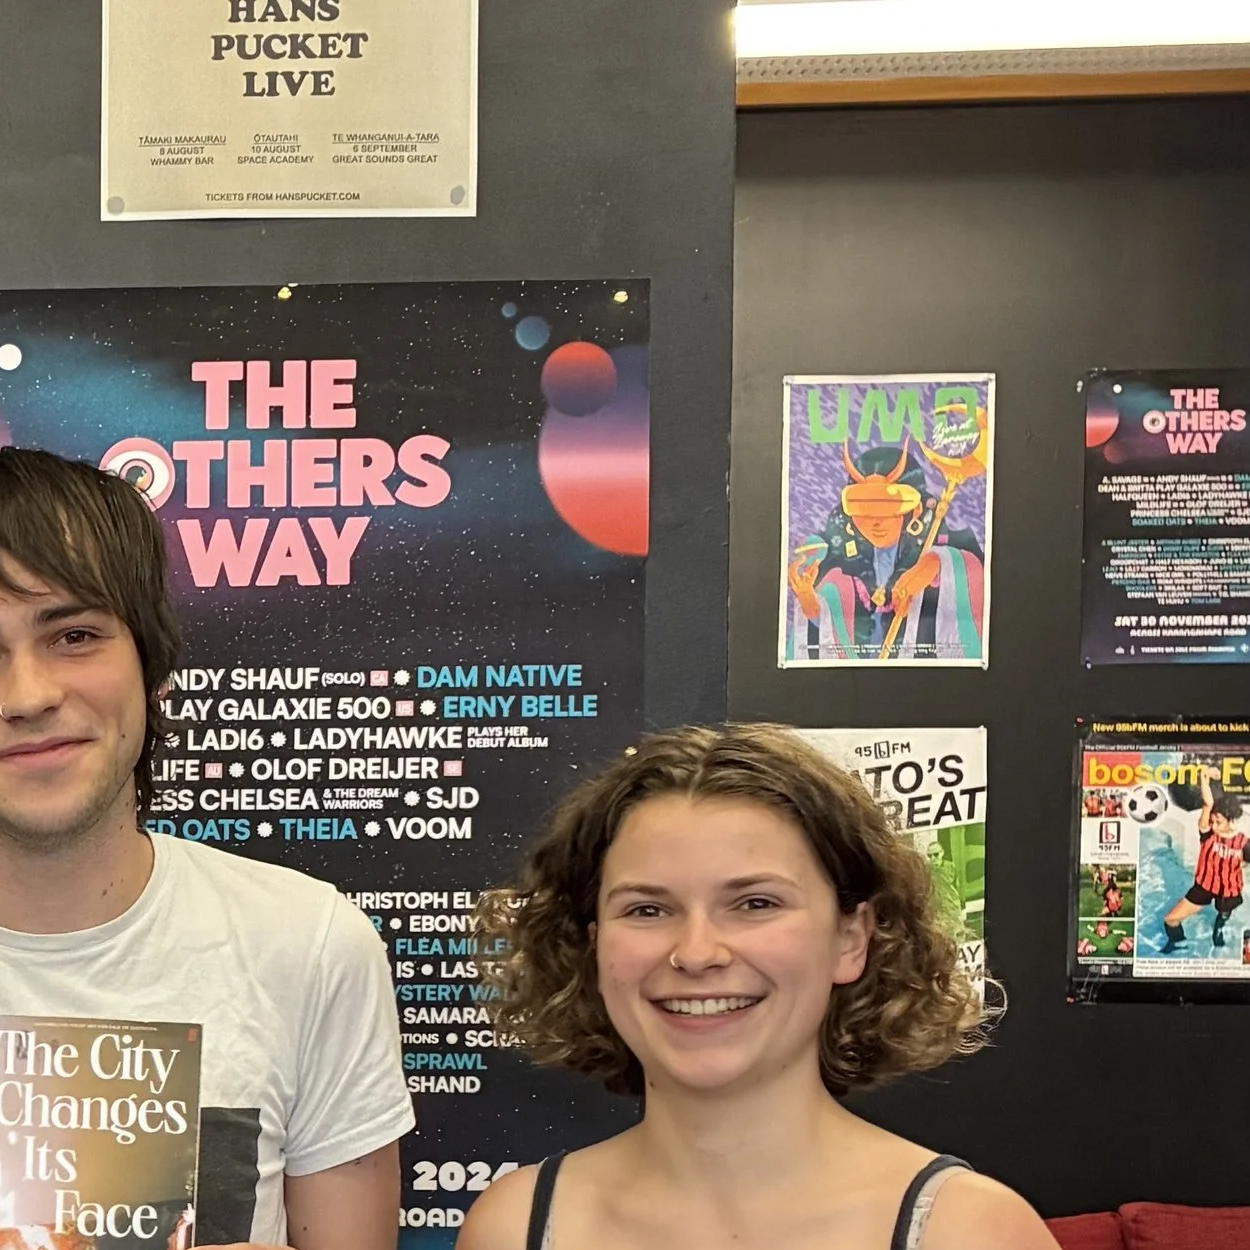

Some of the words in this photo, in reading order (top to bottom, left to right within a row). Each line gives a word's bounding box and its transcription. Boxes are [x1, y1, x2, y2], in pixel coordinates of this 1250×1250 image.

[228, 0, 340, 22] HANS
[211, 33, 368, 60] PUCKET
[243, 70, 335, 97] LIVE
[174, 134, 226, 145] MAKAURAU
[332, 133, 344, 143] TE
[361, 144, 417, 153] SEPTEMBER
[167, 146, 204, 155] AUGUST
[237, 156, 267, 165] SPACE
[269, 155, 314, 164] ACADEMY
[251, 145, 260, 154] 10
[262, 145, 301, 154] AUGUST
[332, 155, 363, 164] GREAT
[365, 155, 405, 163] SOUNDS
[408, 154, 438, 163] GREAT
[150, 157, 192, 166] WHAMMY
[195, 156, 214, 165] BAR
[206, 193, 244, 202] TICKETS
[247, 193, 273, 201] FROM
[275, 192, 360, 201] HANSPUCKET.COM
[191, 359, 357, 430] THE
[1170, 388, 1220, 409] THE
[1143, 410, 1246, 433] OTHERS
[1165, 433, 1222, 454] WAY
[99, 434, 451, 512] OTHERS
[176, 516, 372, 588] WAY
[169, 668, 226, 692] NDY
[230, 667, 320, 692] SHAUF
[321, 672, 366, 687] (SOLO)
[417, 665, 478, 688] DAM
[485, 664, 582, 687] NATIVE
[160, 699, 213, 721] LAY
[218, 698, 331, 721] GALAXIE
[337, 696, 391, 719] 500
[443, 695, 516, 718] ERNY
[521, 694, 598, 718] BELLE
[187, 728, 264, 751] LADI6
[293, 726, 463, 750] LADYHAWKE
[467, 727, 502, 737] PLAYS
[504, 726, 528, 737] HER
[467, 737, 505, 748] DEBUT
[507, 737, 549, 748] ALBUM
[150, 759, 200, 782] LIFE
[251, 758, 322, 781] OLOF
[328, 757, 439, 780] DREIJER
[860, 754, 964, 798] TO'S
[1088, 756, 1203, 785] bosom
[200, 788, 319, 811] CHELSEA
[335, 789, 356, 798] THE
[361, 788, 399, 798] DREAM
[426, 787, 479, 810] SJD
[323, 799, 384, 809] WARRIORS
[884, 787, 987, 832] REAT
[183, 820, 251, 842] OATS
[279, 819, 358, 841] THEIA
[388, 818, 472, 840] VOOM
[346, 891, 448, 910] HRISTOPH
[409, 915, 480, 932] EBONY
[393, 984, 468, 1001] YSTERY
[403, 1007, 491, 1024] SAMARA
[90, 1033, 180, 1094] City
[403, 1053, 488, 1070] SPRAWL
[23, 1135, 78, 1184] Its
[53, 1190, 159, 1239] Face
